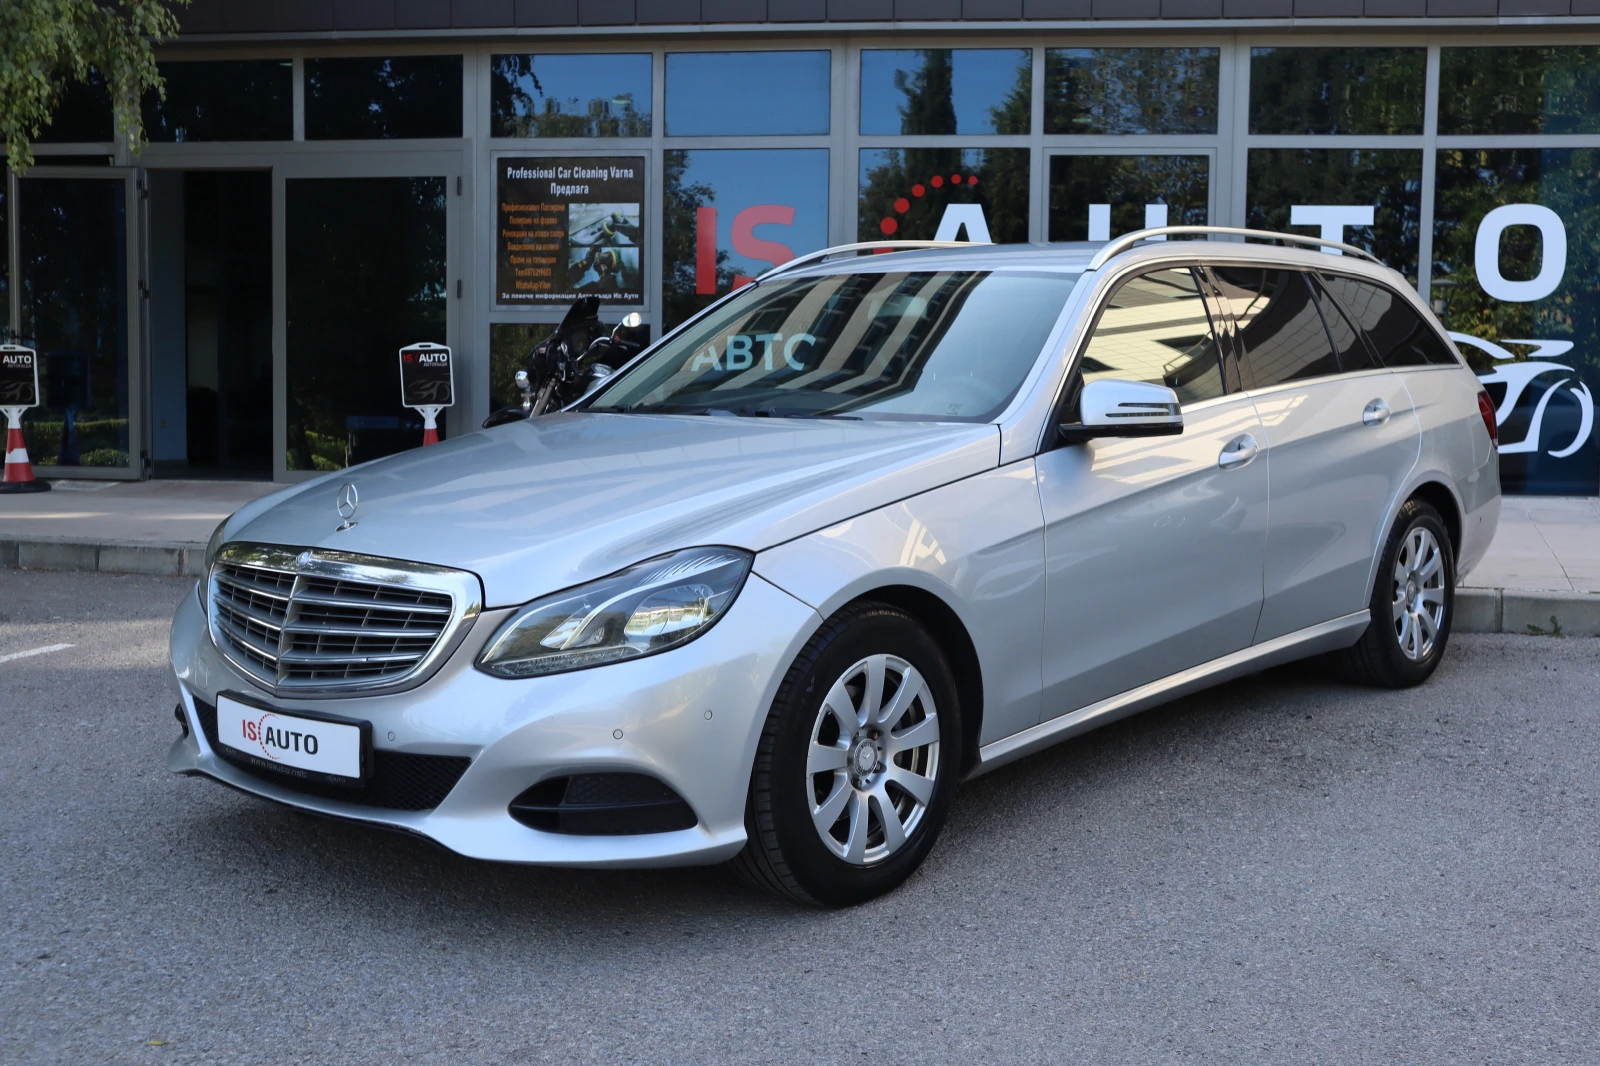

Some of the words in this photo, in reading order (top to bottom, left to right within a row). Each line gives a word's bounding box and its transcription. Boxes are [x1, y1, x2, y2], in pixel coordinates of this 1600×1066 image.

[507, 167, 555, 179] Professional
[558, 167, 571, 178] Car
[573, 167, 608, 181] Cleaning
[610, 166, 634, 178] Varna
[551, 183, 589, 196] Предлага
[696, 204, 796, 295] IS
[535, 292, 576, 300] информация
[3, 355, 31, 364] AUTO
[403, 354, 413, 363] IS
[419, 354, 448, 363] AUTO
[242, 719, 257, 742] IS
[265, 726, 318, 755] AUTO
